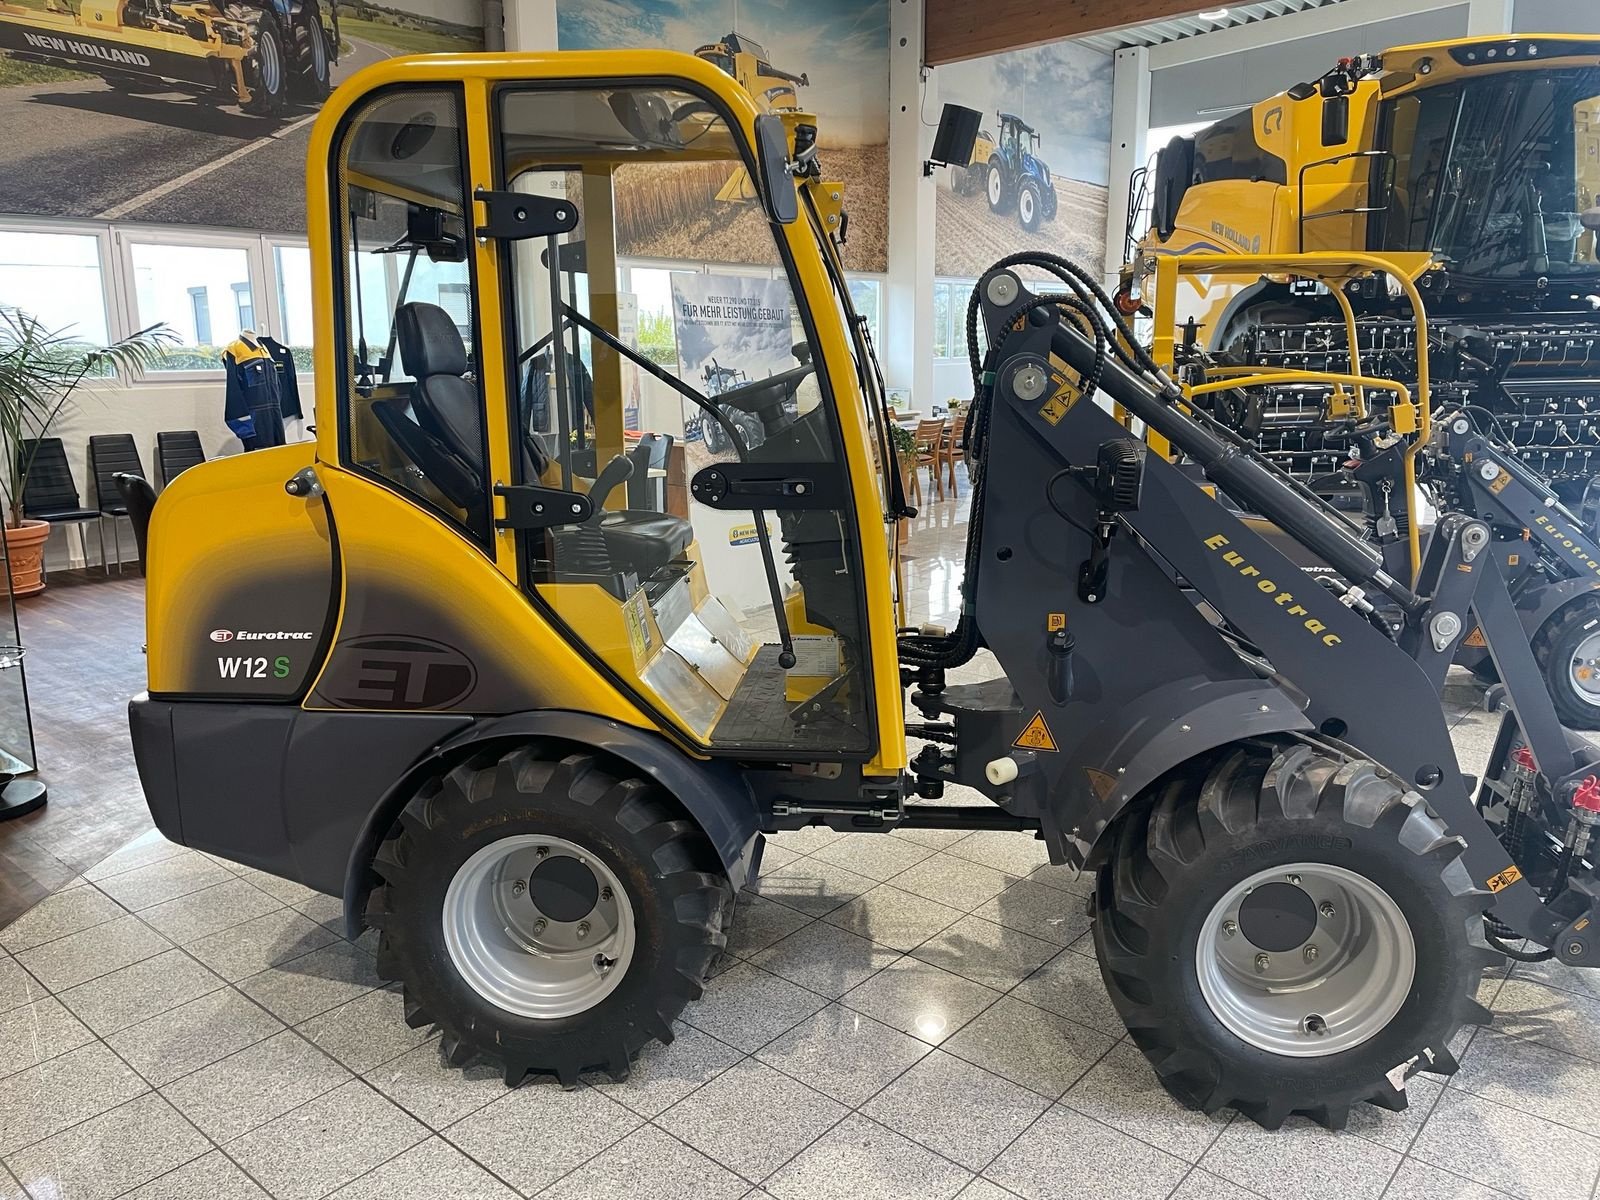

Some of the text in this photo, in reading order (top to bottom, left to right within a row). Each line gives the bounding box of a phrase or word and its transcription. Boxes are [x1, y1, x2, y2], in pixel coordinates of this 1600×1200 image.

[23, 32, 151, 67] NEW HOLLAND
[682, 301, 784, 321] FÜR MEHR LEISTUNG GEBAUT
[1203, 534, 1342, 647] Eurotrac
[236, 631, 313, 640] Eurotrac
[217, 656, 290, 678] W12 S
